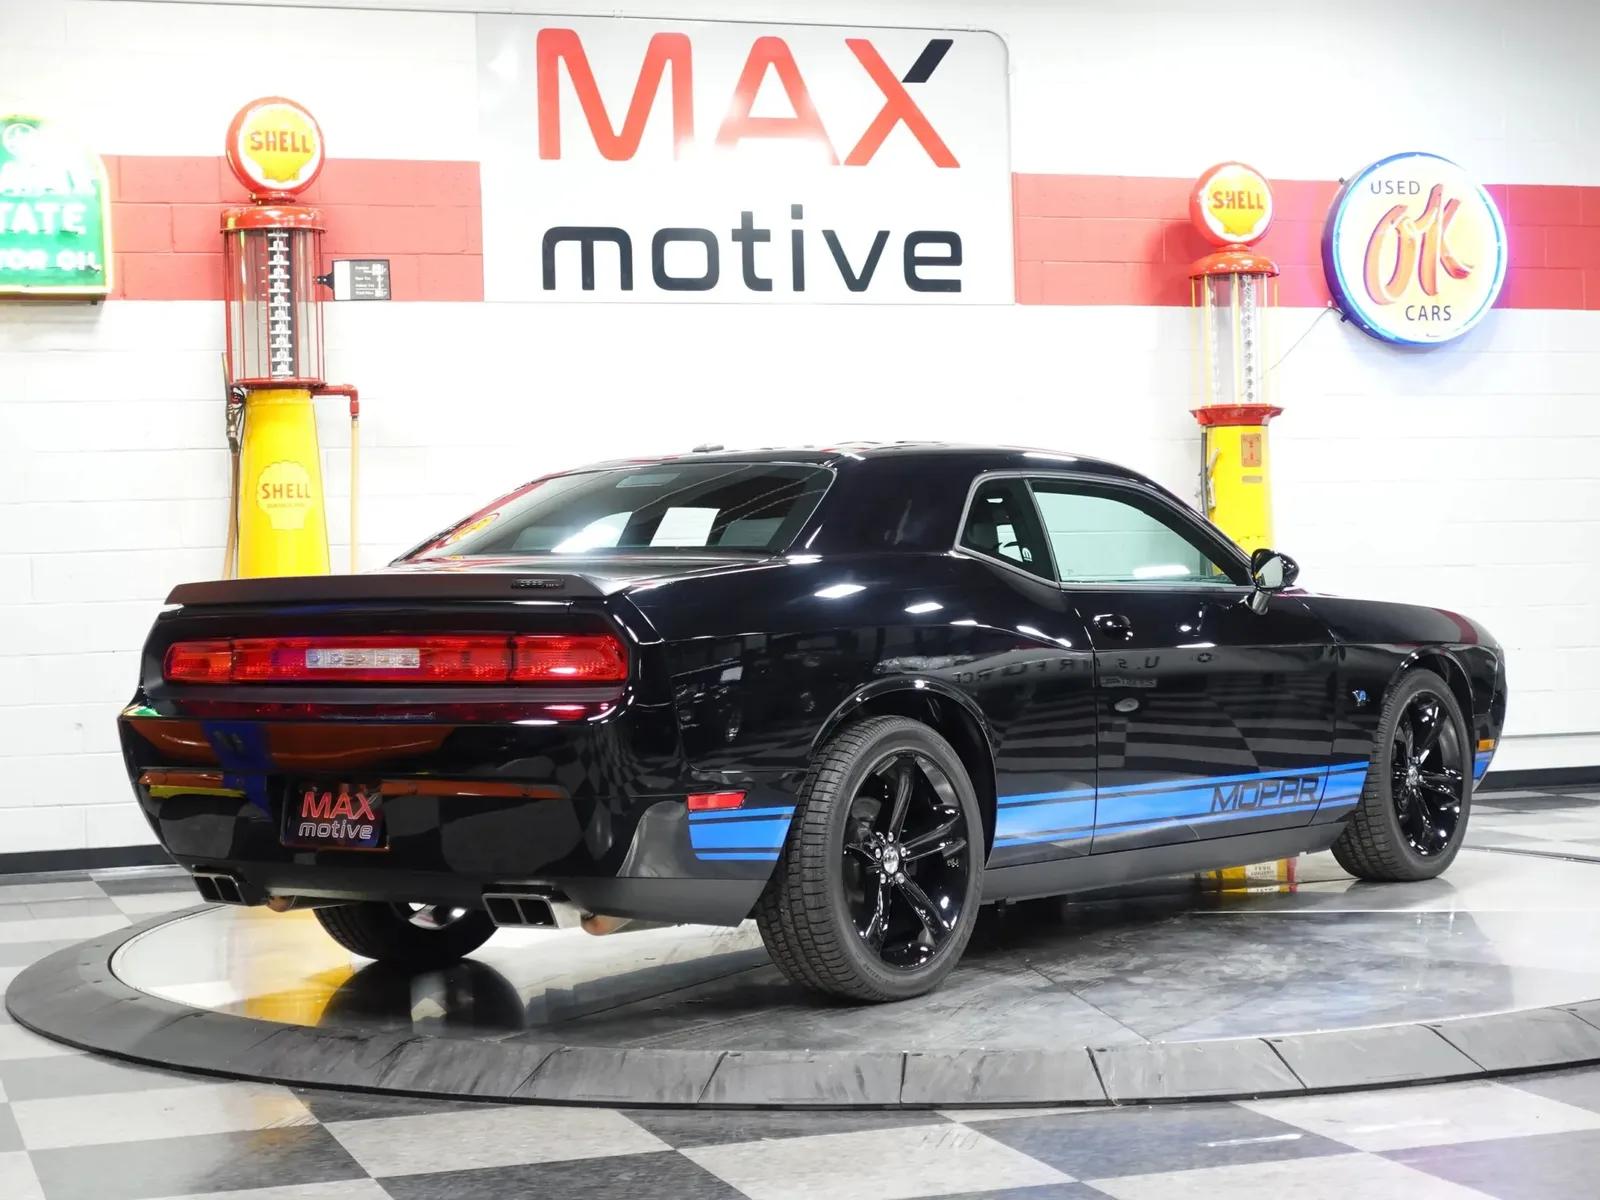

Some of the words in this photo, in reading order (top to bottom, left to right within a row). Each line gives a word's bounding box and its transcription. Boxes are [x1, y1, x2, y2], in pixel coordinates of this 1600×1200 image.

[536, 28, 961, 168] MAX
[250, 130, 311, 154] SHELL
[1212, 190, 1264, 210] SHELL
[1370, 180, 1421, 196] USED
[541, 203, 963, 293] motive
[1363, 183, 1474, 306] OK
[1404, 304, 1452, 322] CARS
[261, 482, 311, 500] SHELL
[301, 791, 378, 821] MAX
[1209, 777, 1319, 813] MOPAR
[298, 819, 374, 840] motive
